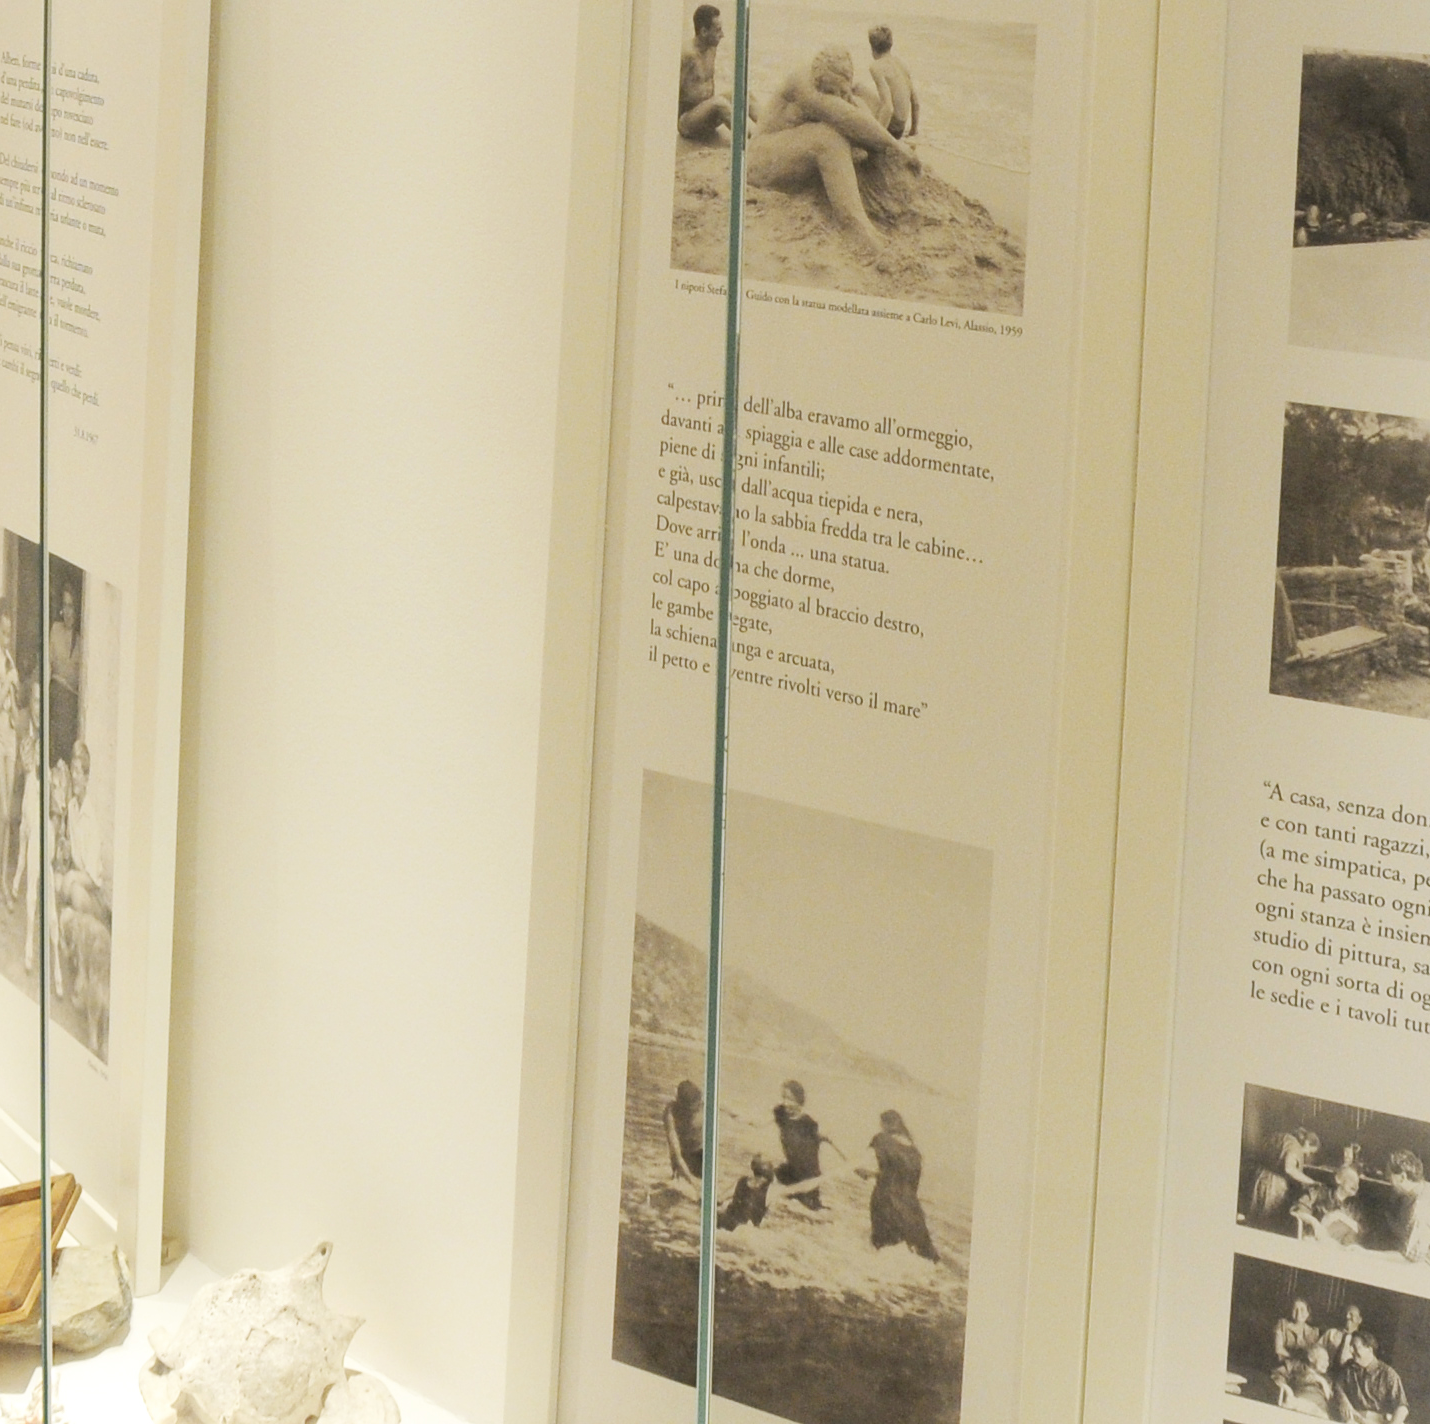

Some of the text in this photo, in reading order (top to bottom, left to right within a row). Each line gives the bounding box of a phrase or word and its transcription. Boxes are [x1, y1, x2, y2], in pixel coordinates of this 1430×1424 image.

[745, 290, 773, 304] Guido
[775, 295, 791, 305] con
[802, 300, 826, 310] statua
[828, 303, 869, 316] modellata
[872, 310, 903, 320] assieme
[913, 313, 937, 325] Carlo
[940, 316, 961, 329] Levi,
[964, 320, 997, 334] Alassio,
[1001, 325, 1023, 337] 1959
[808, 412, 869, 431] eravamo
[661, 409, 994, 482] davanti spiaggia e alle case addormentate,
[669, 466, 693, 485] già,
[819, 491, 868, 515] tiepida
[873, 506, 881, 517] e
[887, 508, 923, 526] nera,
[778, 674, 820, 697] rivolti
[826, 688, 863, 705] verso
[869, 692, 877, 709] il
[1290, 793, 1330, 811] casa,
[1337, 801, 1385, 819] senza
[1260, 817, 1269, 827] e
[1276, 819, 1307, 835] con
[1315, 825, 1355, 844] tanti
[1364, 835, 1429, 858] ragazzi,
[1260, 840, 1275, 859] (a
[1282, 849, 1309, 864] me
[1315, 851, 1406, 884] simpatica,
[1257, 868, 1287, 889] che
[1294, 873, 1314, 894] ha
[1321, 886, 1385, 907] passato
[1255, 903, 1294, 921] ogni
[1301, 911, 1355, 931] stanza
[1362, 917, 1371, 934] è
